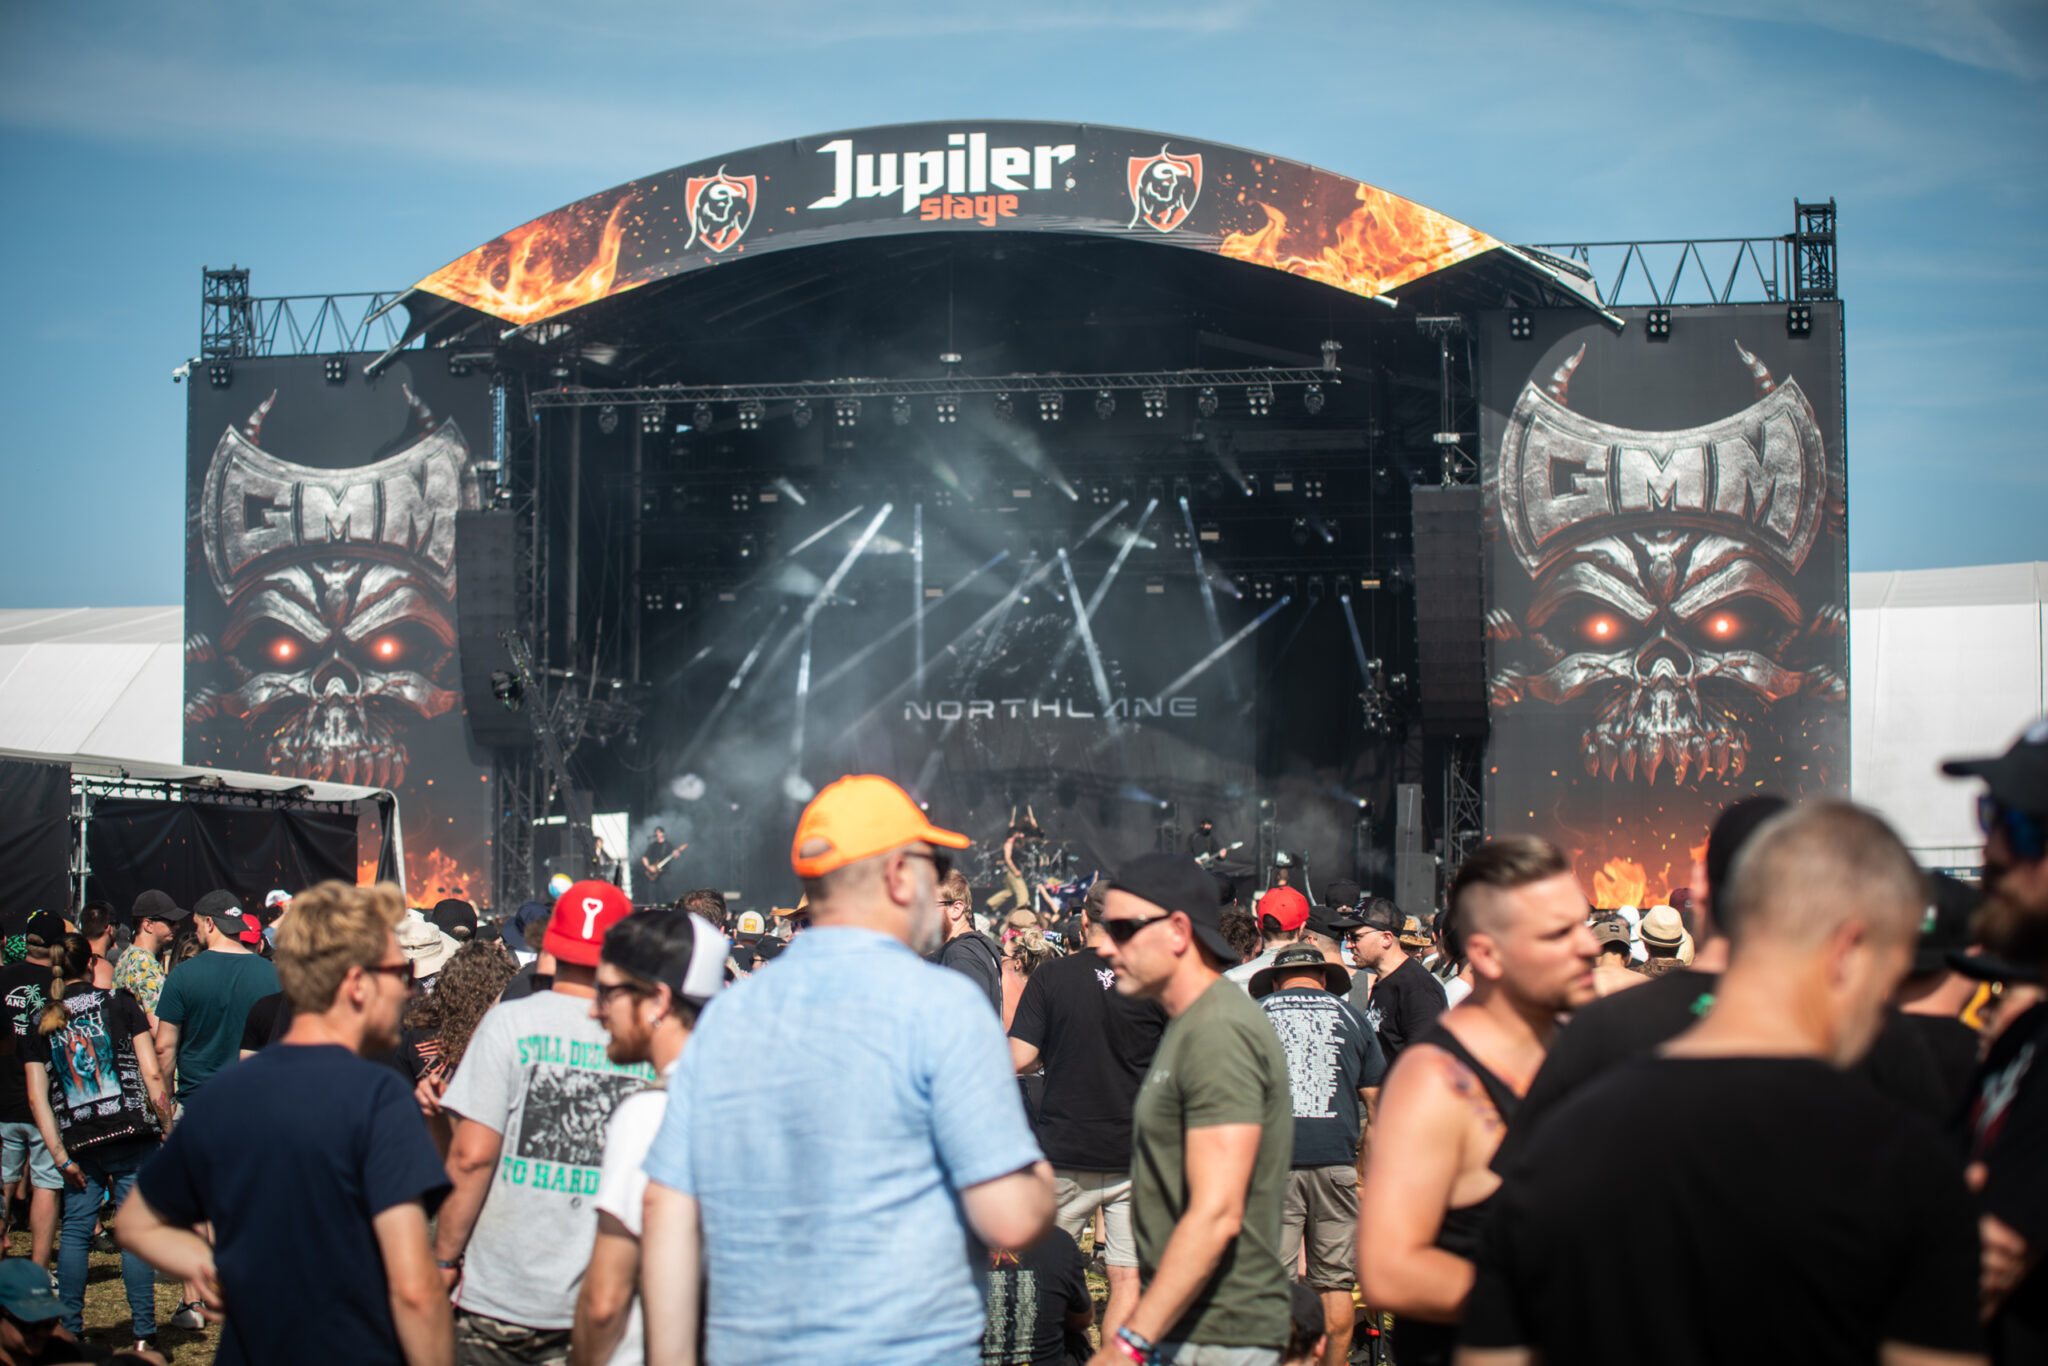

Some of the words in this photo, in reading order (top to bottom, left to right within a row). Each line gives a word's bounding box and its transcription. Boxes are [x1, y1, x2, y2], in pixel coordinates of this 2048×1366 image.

[807, 133, 1076, 213] Jupiler
[920, 194, 1018, 227] stage
[1521, 406, 1803, 549] GMM
[220, 448, 458, 575] GMM
[904, 697, 1197, 720] NORTHLANE
[5, 994, 26, 1008] ANS
